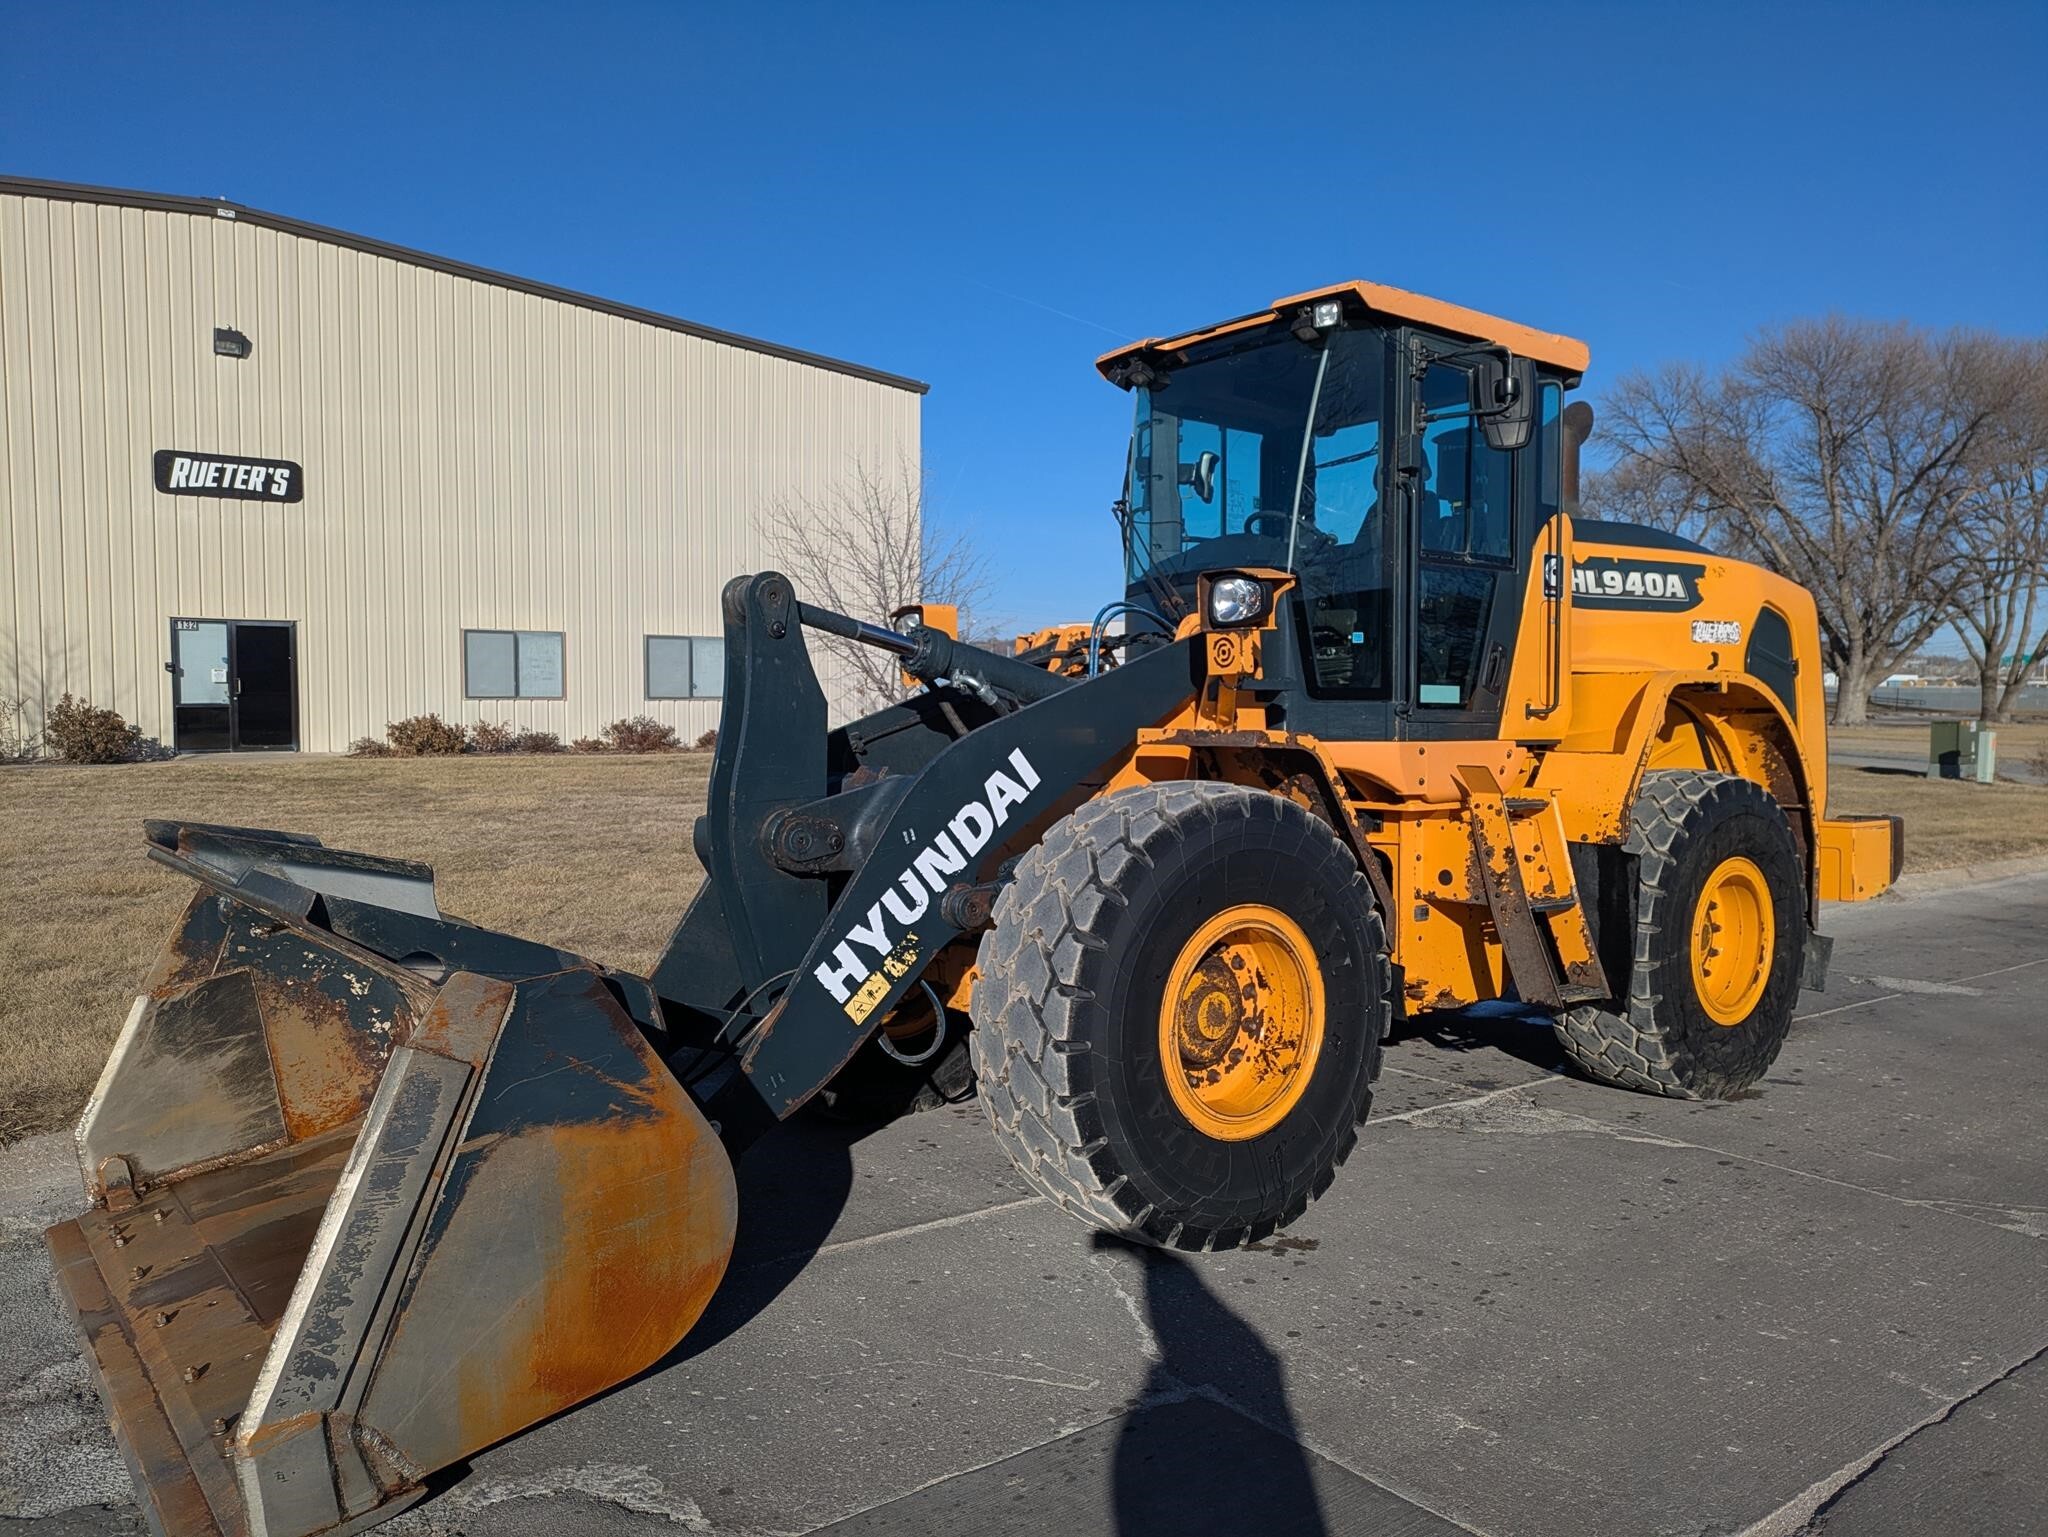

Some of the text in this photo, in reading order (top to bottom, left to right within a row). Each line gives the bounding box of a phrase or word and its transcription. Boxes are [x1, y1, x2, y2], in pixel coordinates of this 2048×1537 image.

[170, 458, 290, 495] RUETER'S
[1571, 567, 1686, 598] HL940A
[813, 747, 1041, 1004] HYUNDAI
